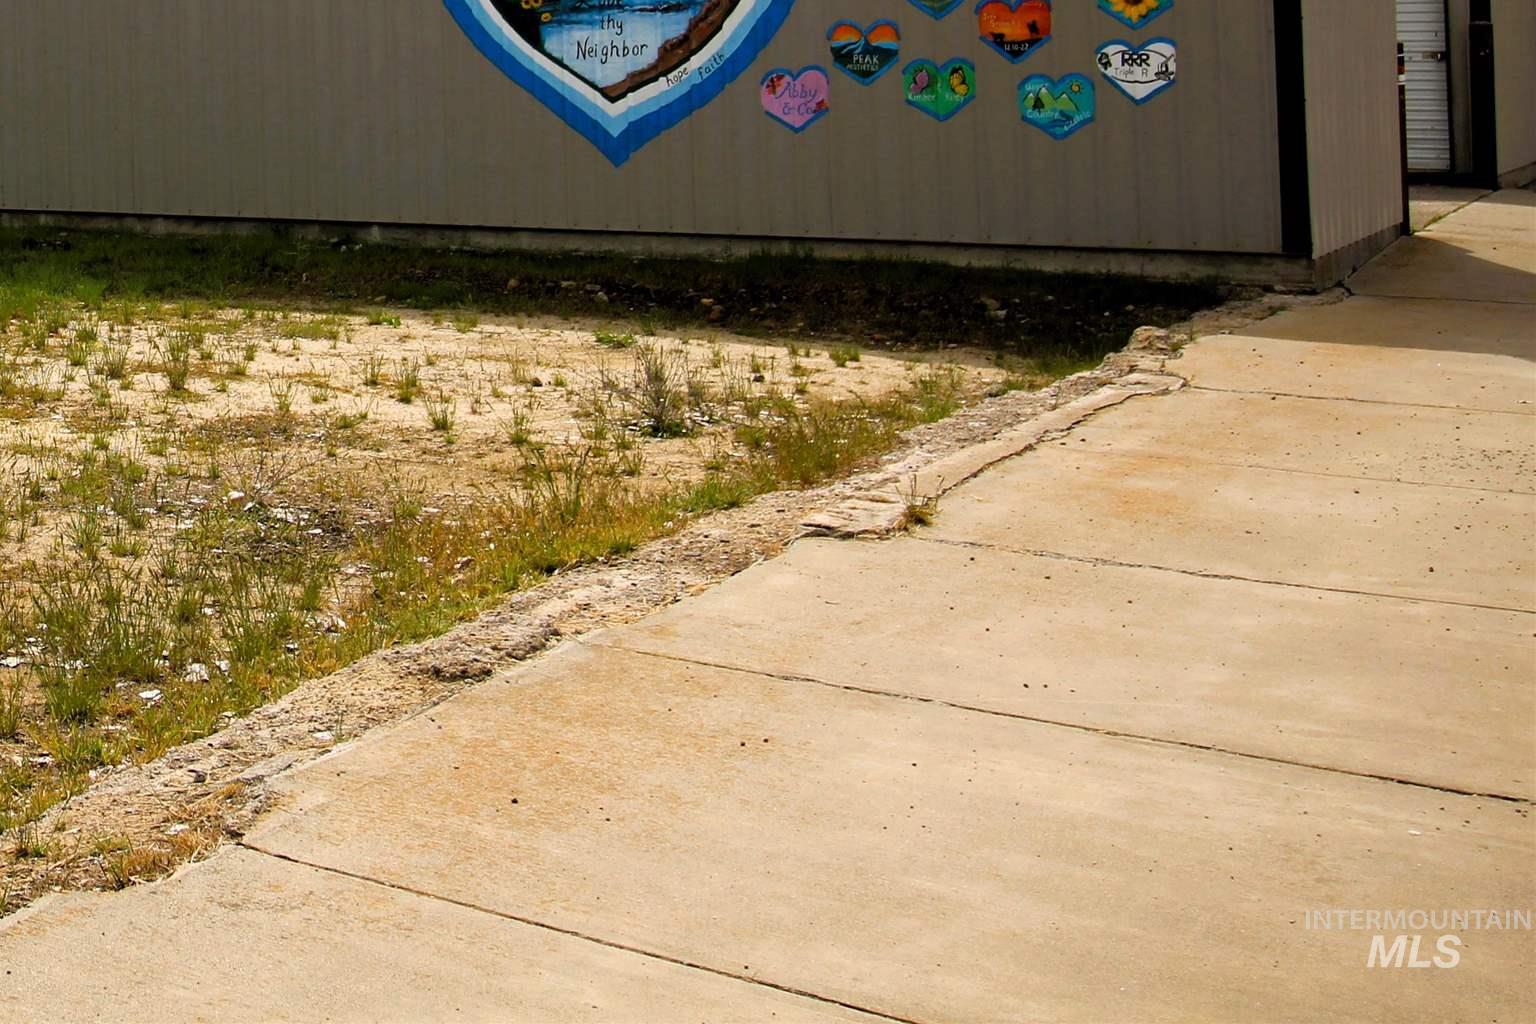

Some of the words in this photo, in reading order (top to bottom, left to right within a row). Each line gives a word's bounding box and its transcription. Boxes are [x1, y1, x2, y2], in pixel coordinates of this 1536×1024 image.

[599, 14, 623, 36] thy
[576, 36, 649, 65] Neighbor
[852, 53, 880, 65] PEAK
[1121, 52, 1151, 67] RRR
[665, 67, 689, 88] hope
[1141, 67, 1148, 78] R
[775, 81, 818, 103] Abby
